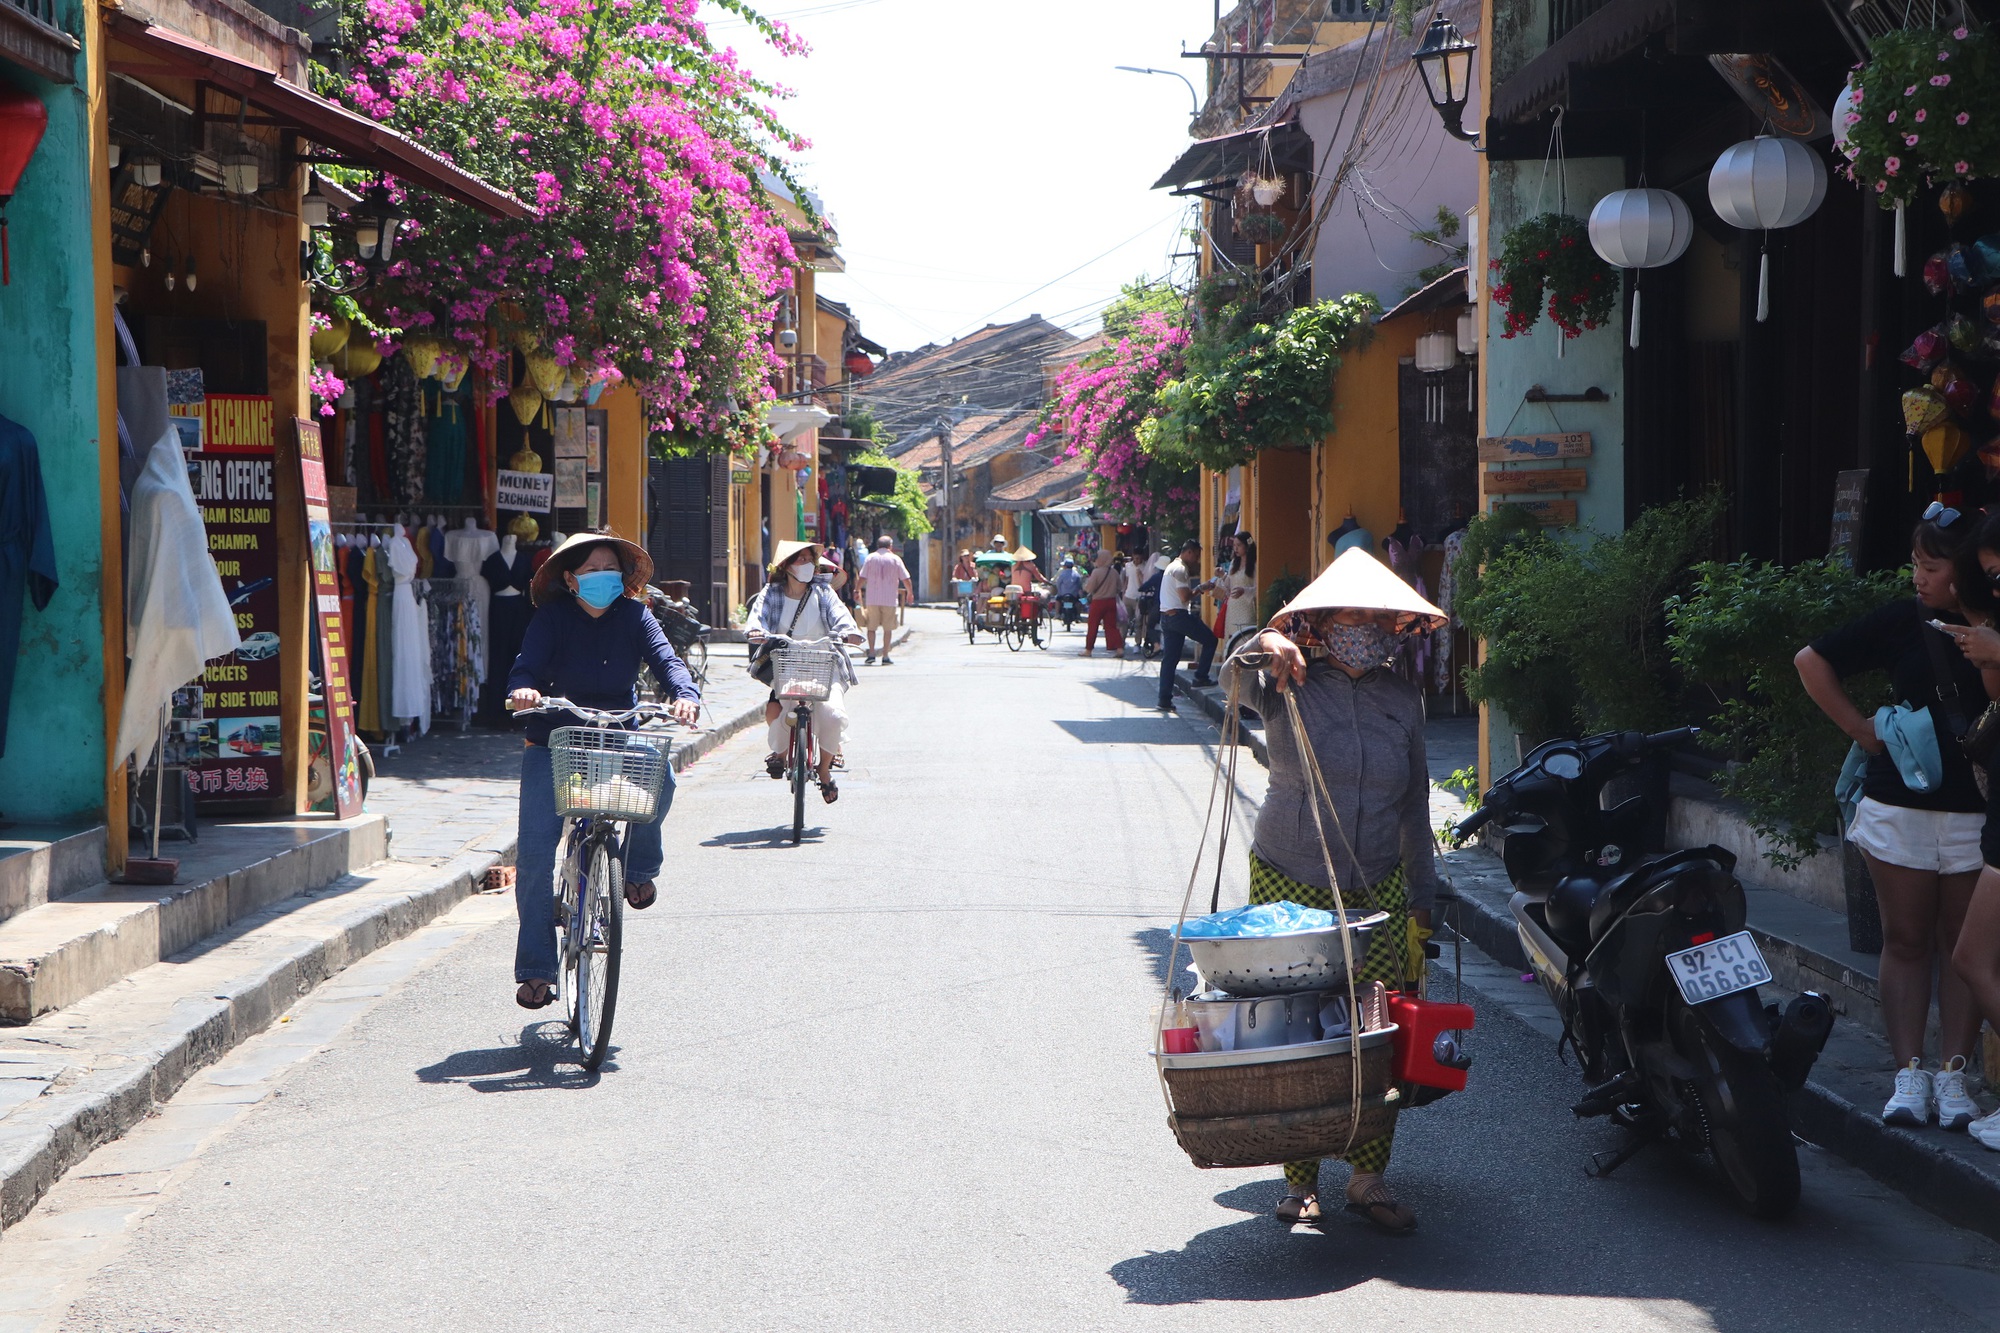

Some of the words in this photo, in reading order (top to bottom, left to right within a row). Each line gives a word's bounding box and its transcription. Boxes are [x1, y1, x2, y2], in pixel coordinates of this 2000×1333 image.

[211, 399, 275, 446] EXCHANGE
[200, 460, 222, 500] NG
[225, 460, 273, 500] OFFICE
[499, 474, 550, 491] MONEY
[732, 471, 752, 479] ATM
[498, 491, 549, 508] EXCHANGE
[202, 508, 226, 523] HAM
[230, 508, 271, 523] ISLAND
[209, 534, 259, 550] CHAMPA
[216, 561, 241, 576] OUR
[203, 692, 217, 708] RY
[220, 691, 246, 708] SIDE
[249, 690, 279, 707] TOUR
[1681, 939, 1745, 975] 92-C1
[1684, 959, 1767, 999] 056.69
